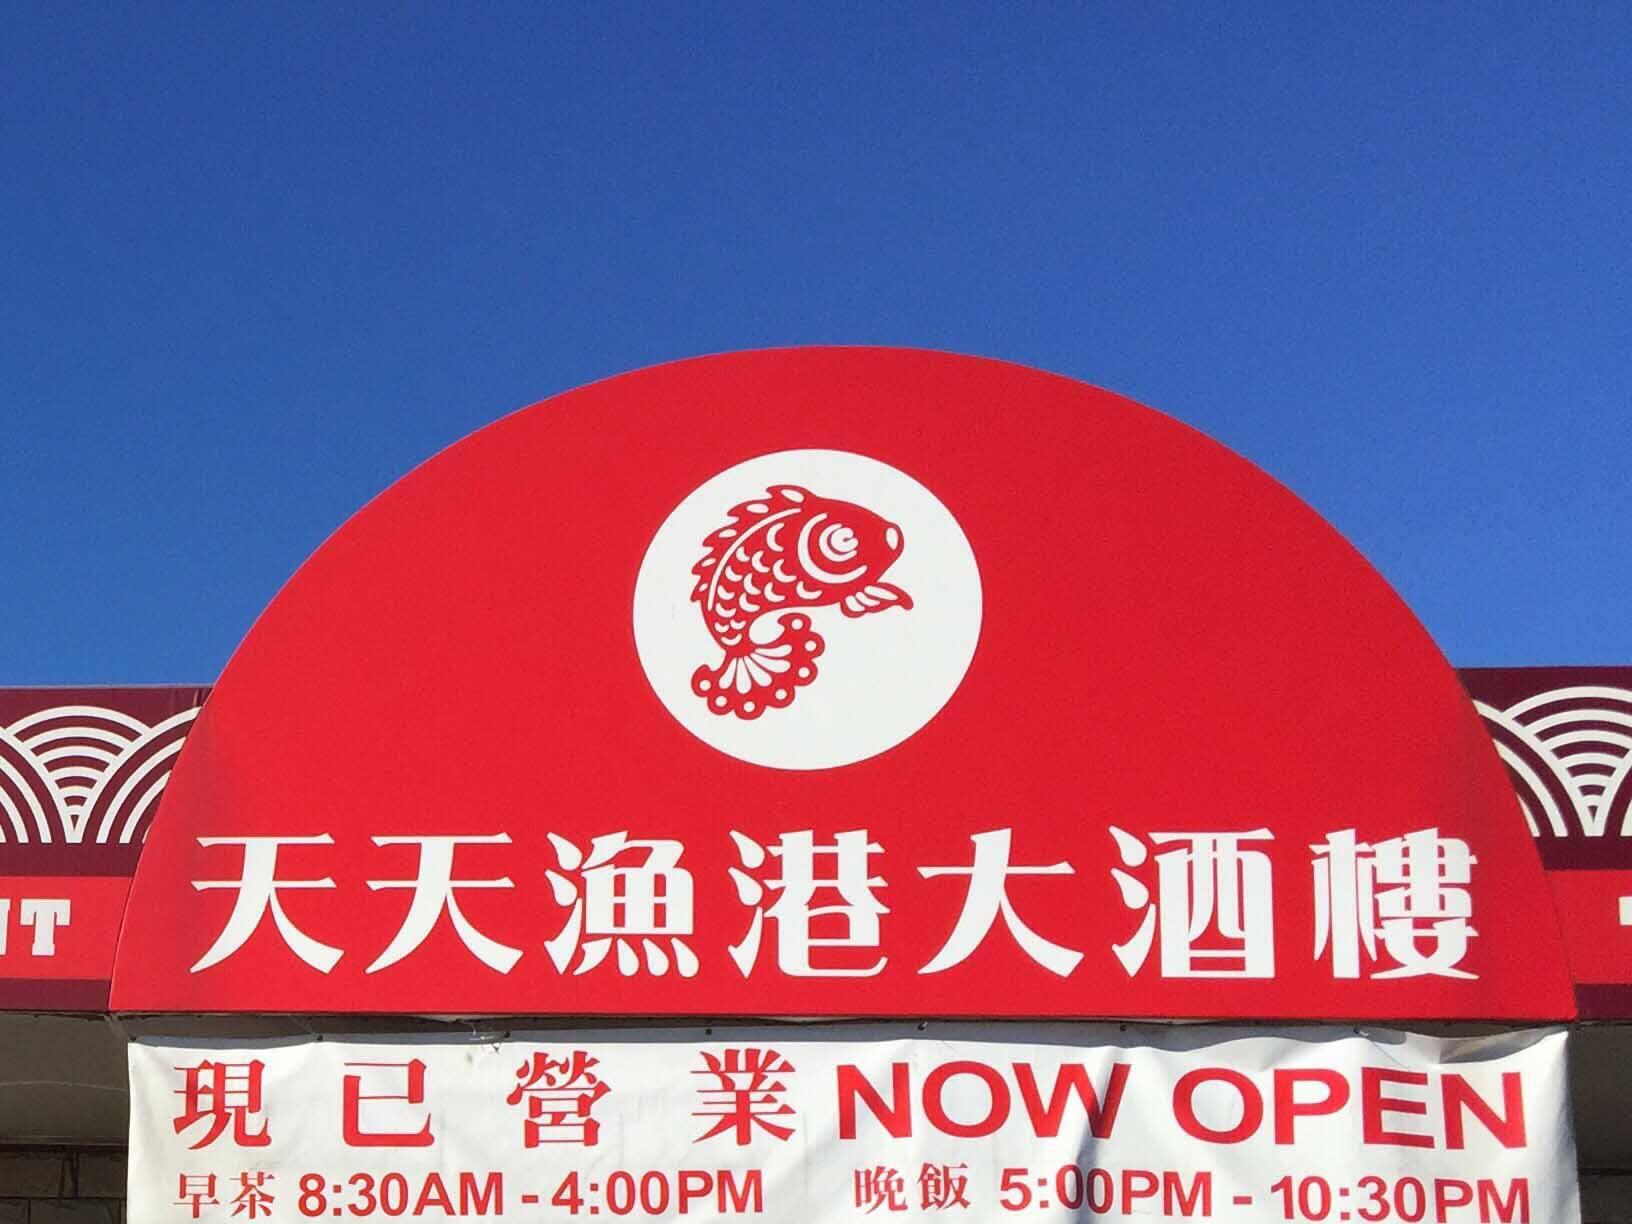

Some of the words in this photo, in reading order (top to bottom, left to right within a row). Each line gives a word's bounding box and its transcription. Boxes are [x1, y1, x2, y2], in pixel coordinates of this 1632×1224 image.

[191, 826, 1480, 982] 天天漁港大酒樓
[172, 1048, 797, 1151] 現已營業
[837, 1061, 1132, 1142] NOW
[1172, 1066, 1528, 1152] OPEN
[176, 1172, 276, 1220] 早茶
[298, 1172, 505, 1218] 8:30AM
[552, 1170, 765, 1217] 4:00PM
[853, 1162, 970, 1214] 晚飯
[1000, 1163, 1214, 1218] 5:00PM
[1272, 1175, 1531, 1224] 10:30PM
